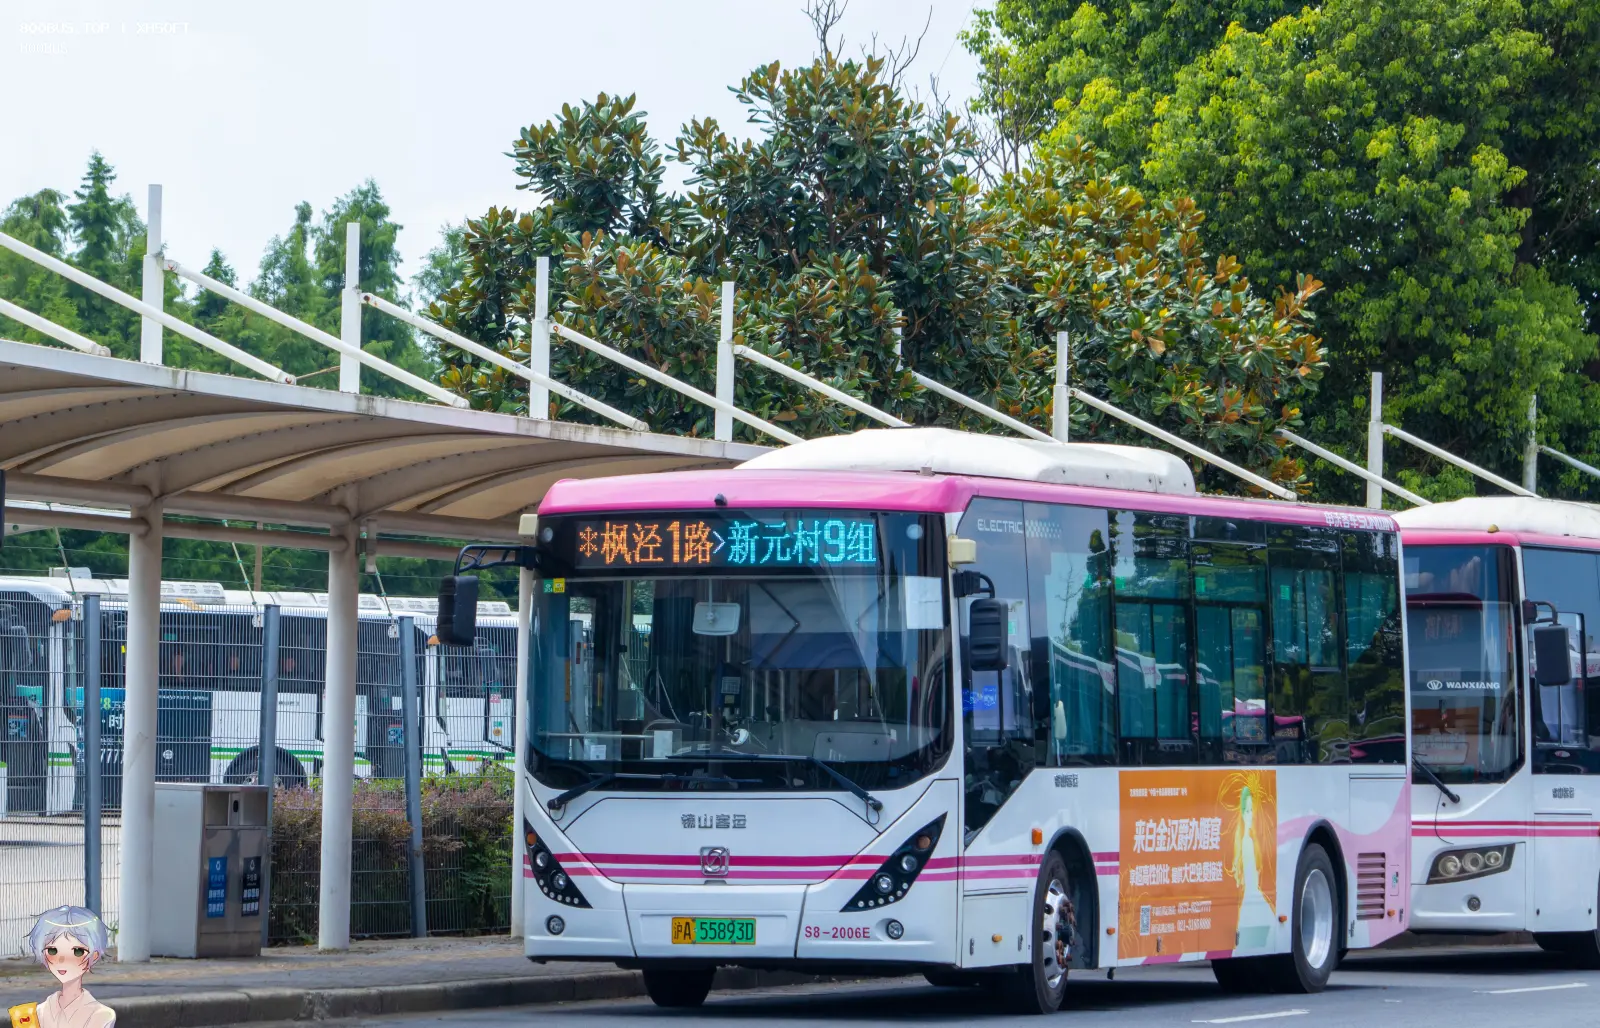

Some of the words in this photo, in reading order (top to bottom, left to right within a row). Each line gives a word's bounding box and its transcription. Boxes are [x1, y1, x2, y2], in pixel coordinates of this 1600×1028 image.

[977, 518, 1023, 534] ELECTRIC
[600, 520, 714, 565] 枫泾1路
[727, 520, 877, 564] 新元村9组
[1446, 681, 1501, 690] WANXIANG
[804, 925, 871, 939] S8-2006E
